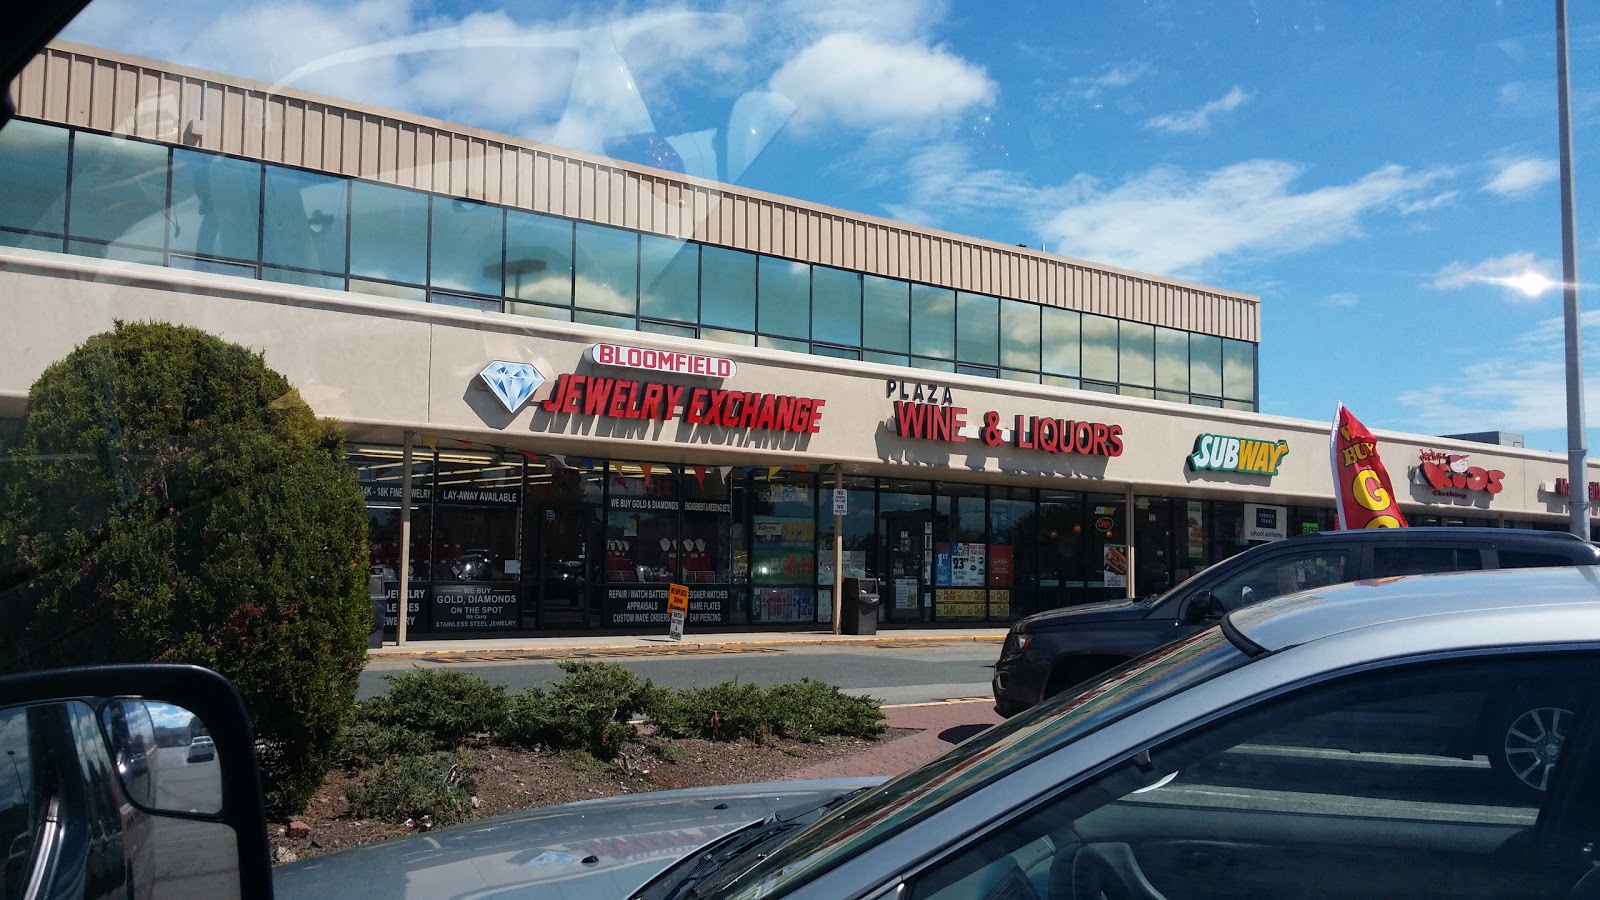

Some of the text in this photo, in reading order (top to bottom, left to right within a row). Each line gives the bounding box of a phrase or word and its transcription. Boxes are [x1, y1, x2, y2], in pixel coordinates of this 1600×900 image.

[599, 344, 731, 378] BLOOMFIELD
[886, 379, 953, 405] PLAZA
[543, 373, 826, 434] JEWELRY EXCHANGE
[894, 400, 1123, 457] WINE & LIQUORS
[1192, 433, 1289, 475] SUBWAY
[1341, 441, 1375, 467] BUY
[443, 490, 517, 502] LAY-AWAY AVAILABLE
[1432, 489, 1467, 499] Clothing
[610, 499, 619, 508] WE
[620, 499, 631, 508] BUY
[631, 500, 646, 509] GOLD
[652, 501, 679, 510] DIAMONDS
[468, 595, 517, 604] DIAMONDS
[608, 590, 628, 599] REPAIR
[450, 606, 503, 614] ON THE SPOT
[626, 601, 659, 611] APPRAISALS
[703, 602, 721, 611] PLATES
[612, 613, 671, 623] CUSTOM MADE ORDERS
[689, 613, 721, 622] EAR PIERCING
